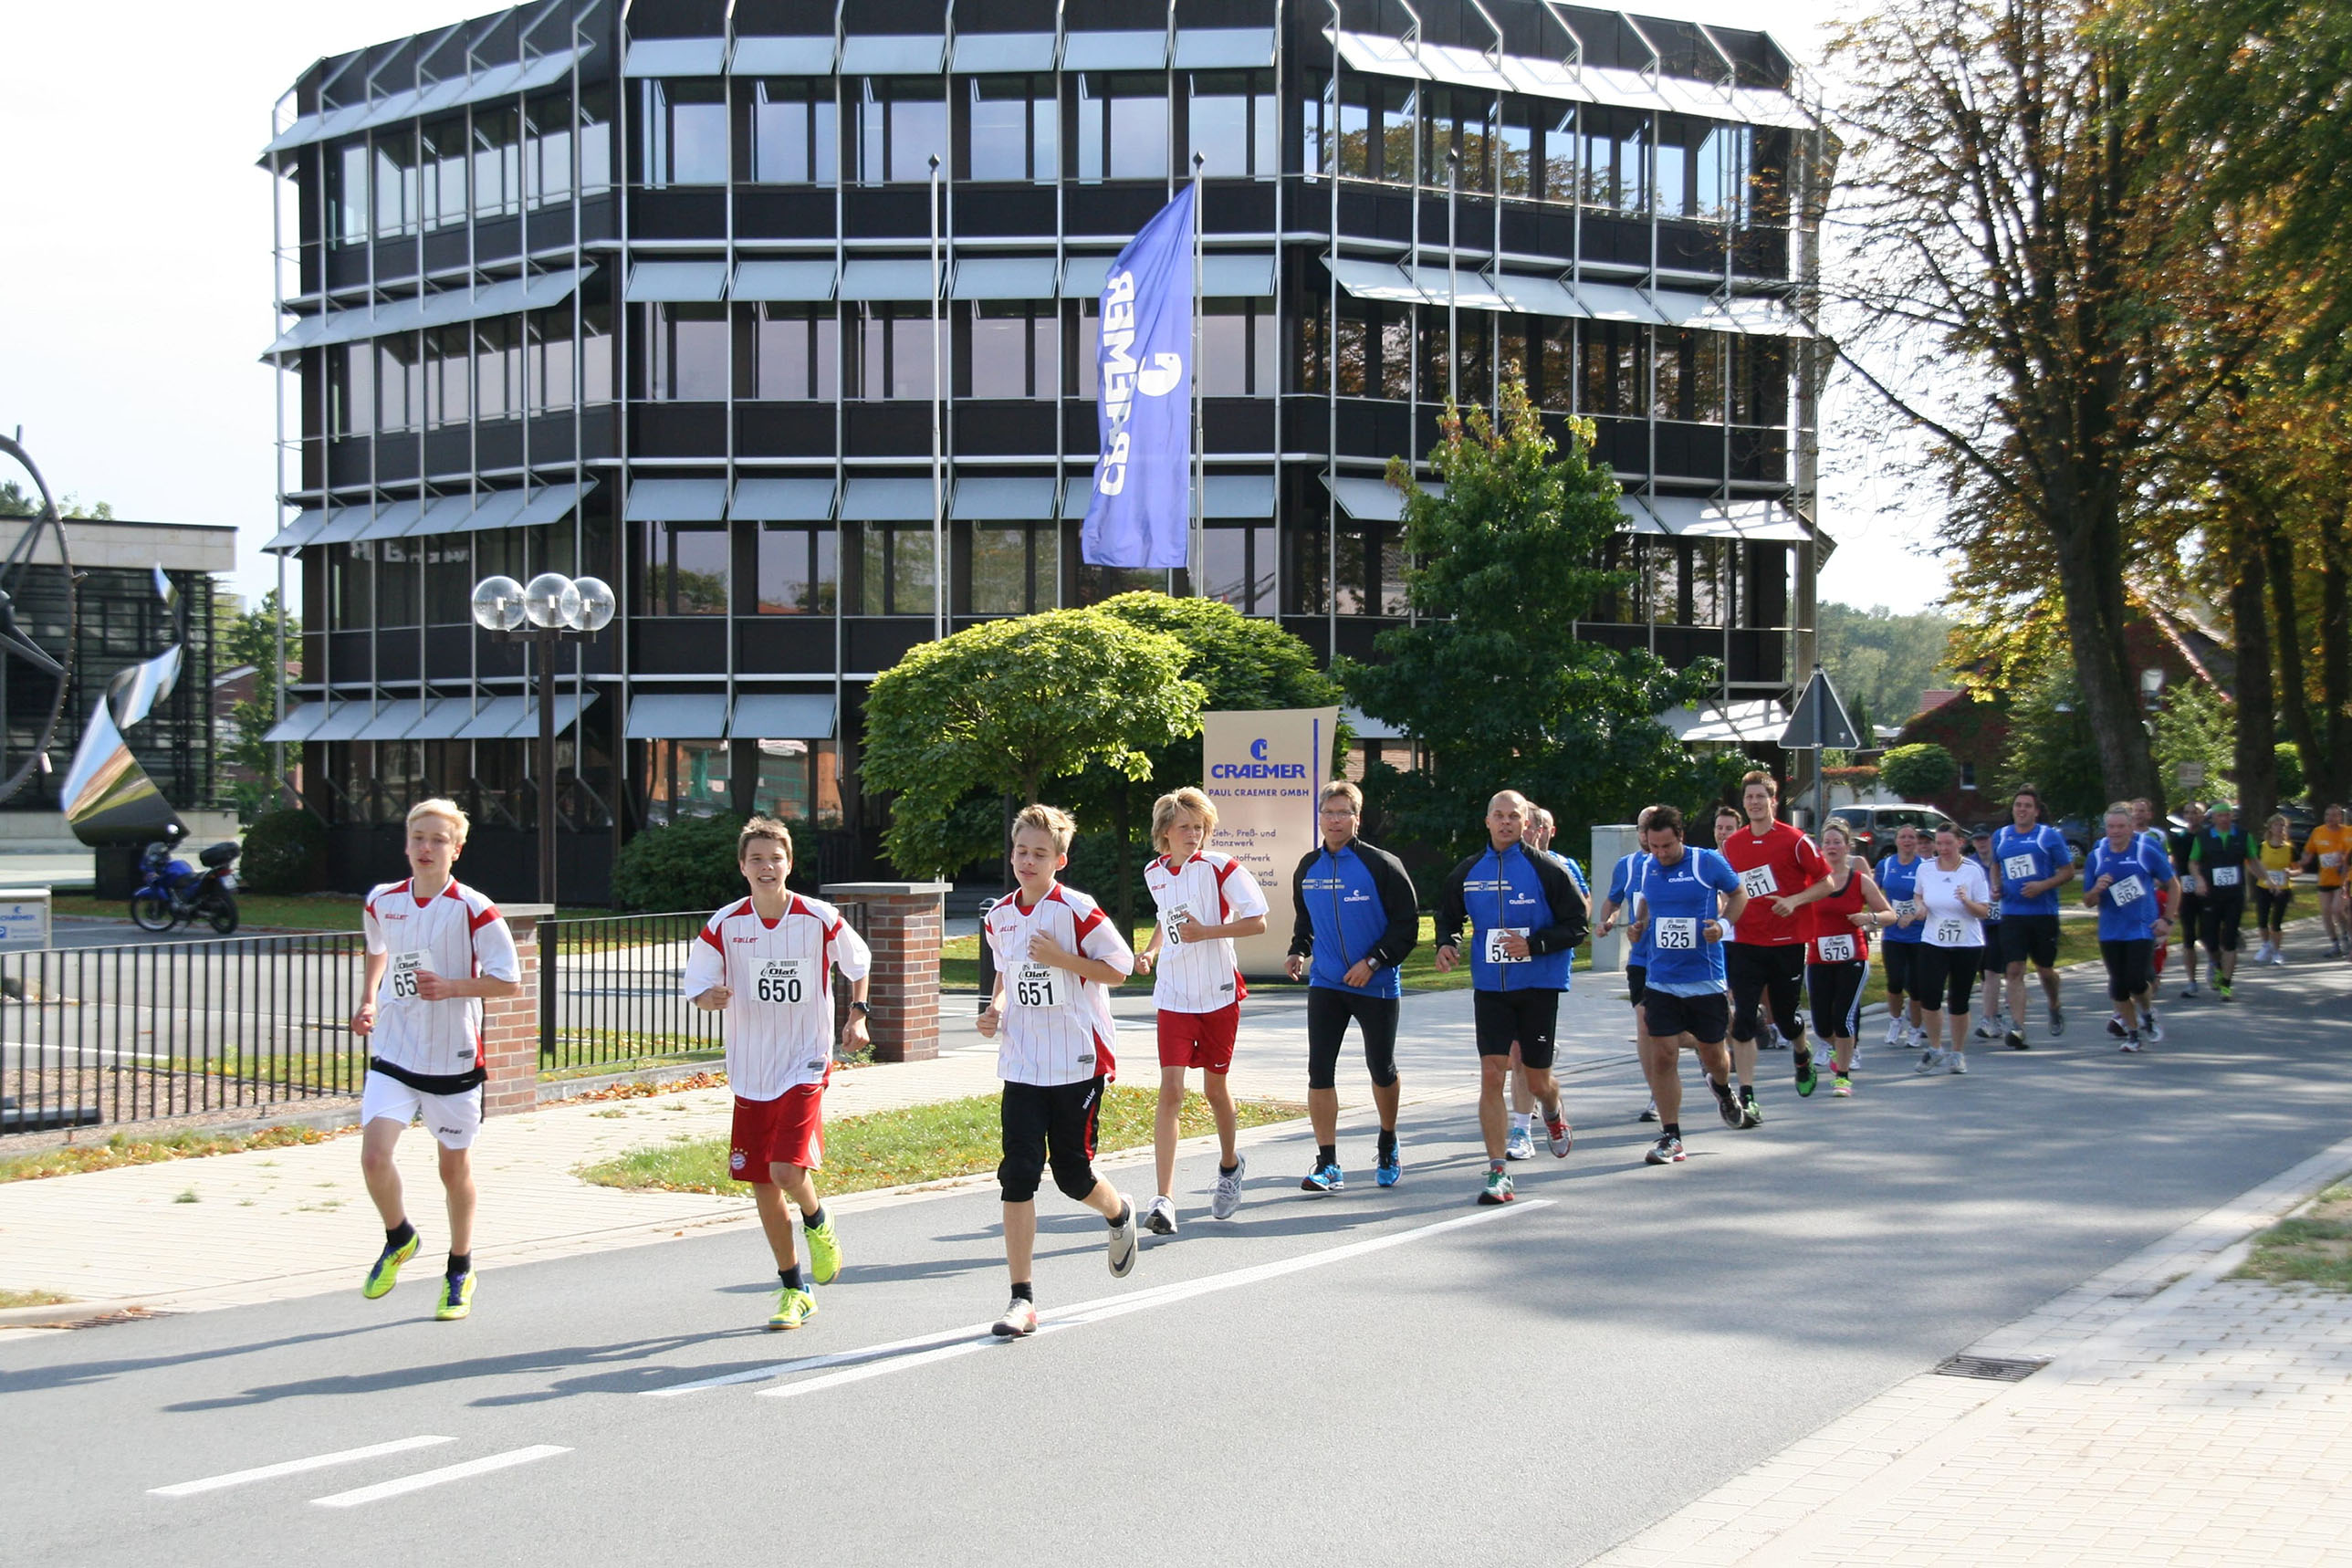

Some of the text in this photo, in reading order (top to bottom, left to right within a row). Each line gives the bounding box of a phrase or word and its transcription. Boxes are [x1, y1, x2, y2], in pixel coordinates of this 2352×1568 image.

[1211, 763, 1306, 779] CRAEMER
[1208, 789, 1309, 797] PAUL CRAEMER GMBH
[1260, 829, 1276, 837] und
[1211, 839, 1254, 847] Stanzwerk
[1258, 869, 1274, 877] und
[2010, 863, 2030, 878] 517
[1745, 878, 1771, 897] 611
[2117, 885, 2141, 904] 562
[1661, 931, 1689, 948] 525
[1938, 928, 1961, 942] 617
[1491, 945, 1523, 962] 54
[1824, 946, 1849, 961] 579
[394, 972, 418, 997] 65
[758, 977, 801, 1003] 650
[1018, 981, 1054, 1006] 651
